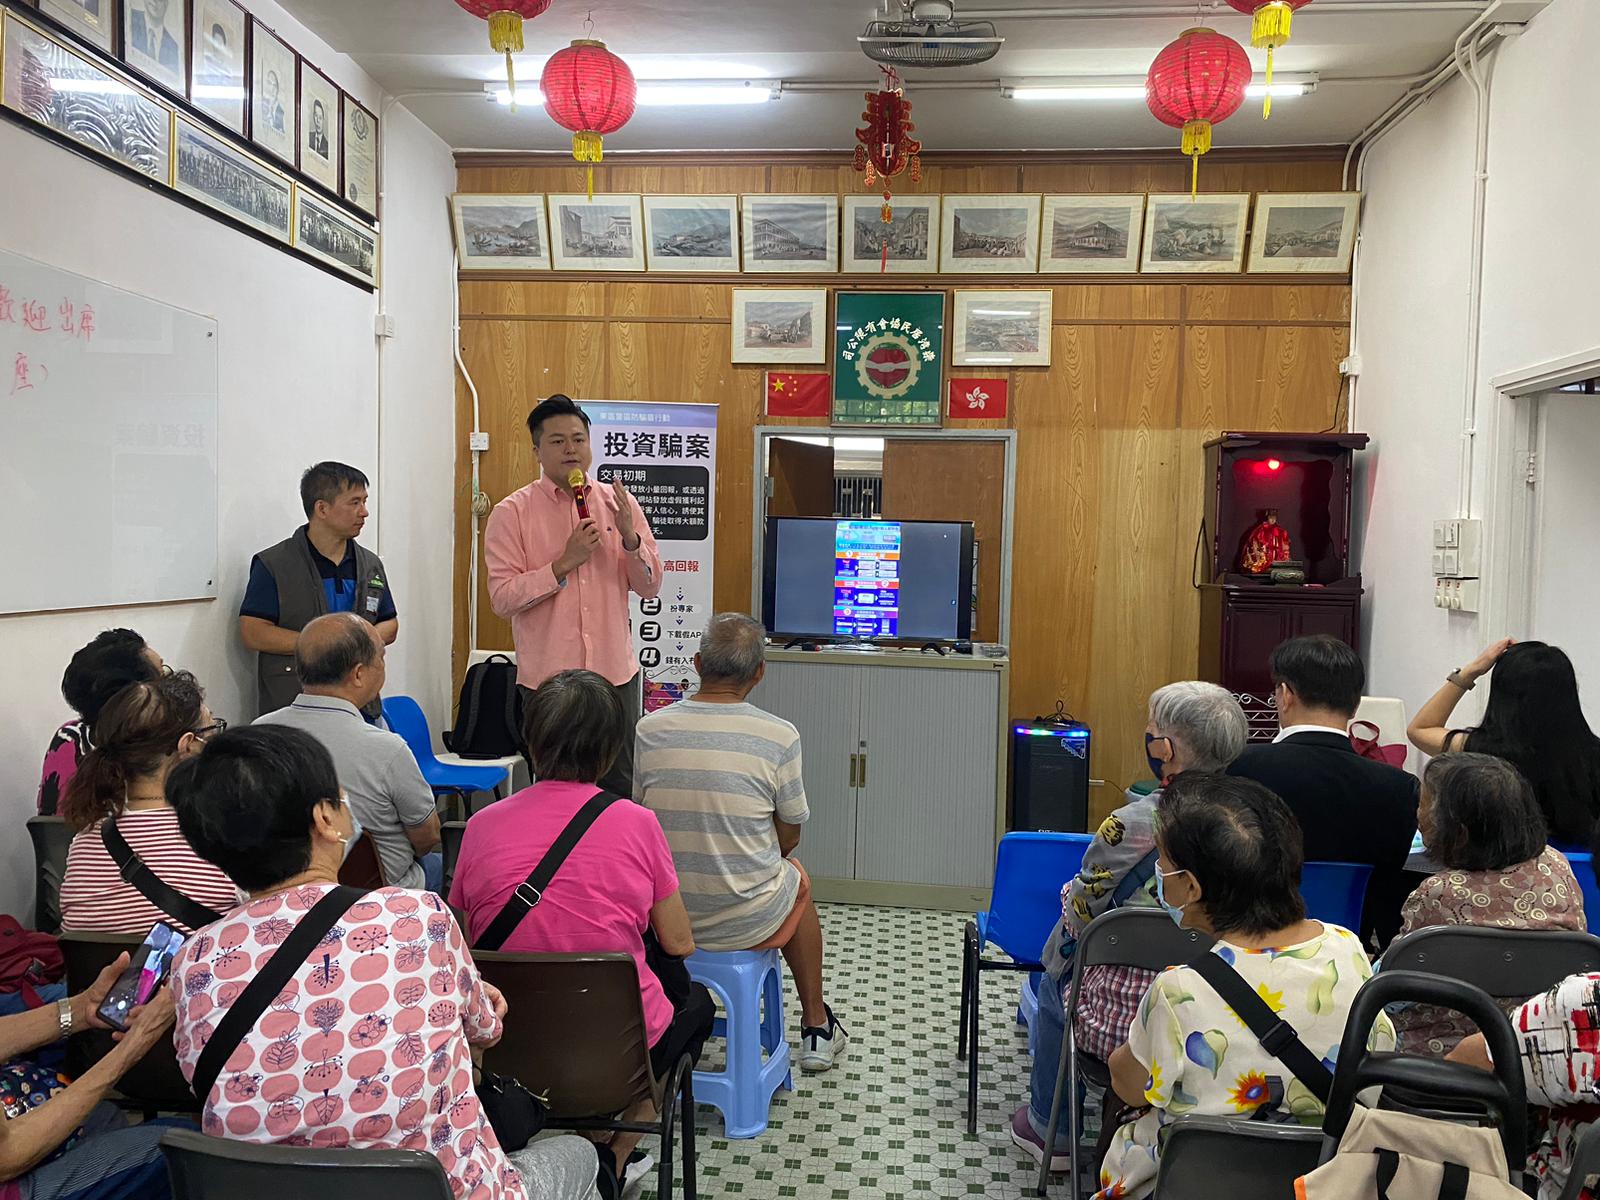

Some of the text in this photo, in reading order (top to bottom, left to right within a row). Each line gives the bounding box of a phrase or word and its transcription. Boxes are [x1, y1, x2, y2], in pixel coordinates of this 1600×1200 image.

[604, 432, 710, 459] 投資騙案
[600, 470, 647, 482] 交易初期
[635, 495, 705, 505] 網站發放虛假獲利記
[663, 560, 699, 572] 高回報
[642, 598, 694, 613] 2 扮專家
[642, 624, 703, 639] 3 下載假AP
[641, 649, 657, 665] 4
